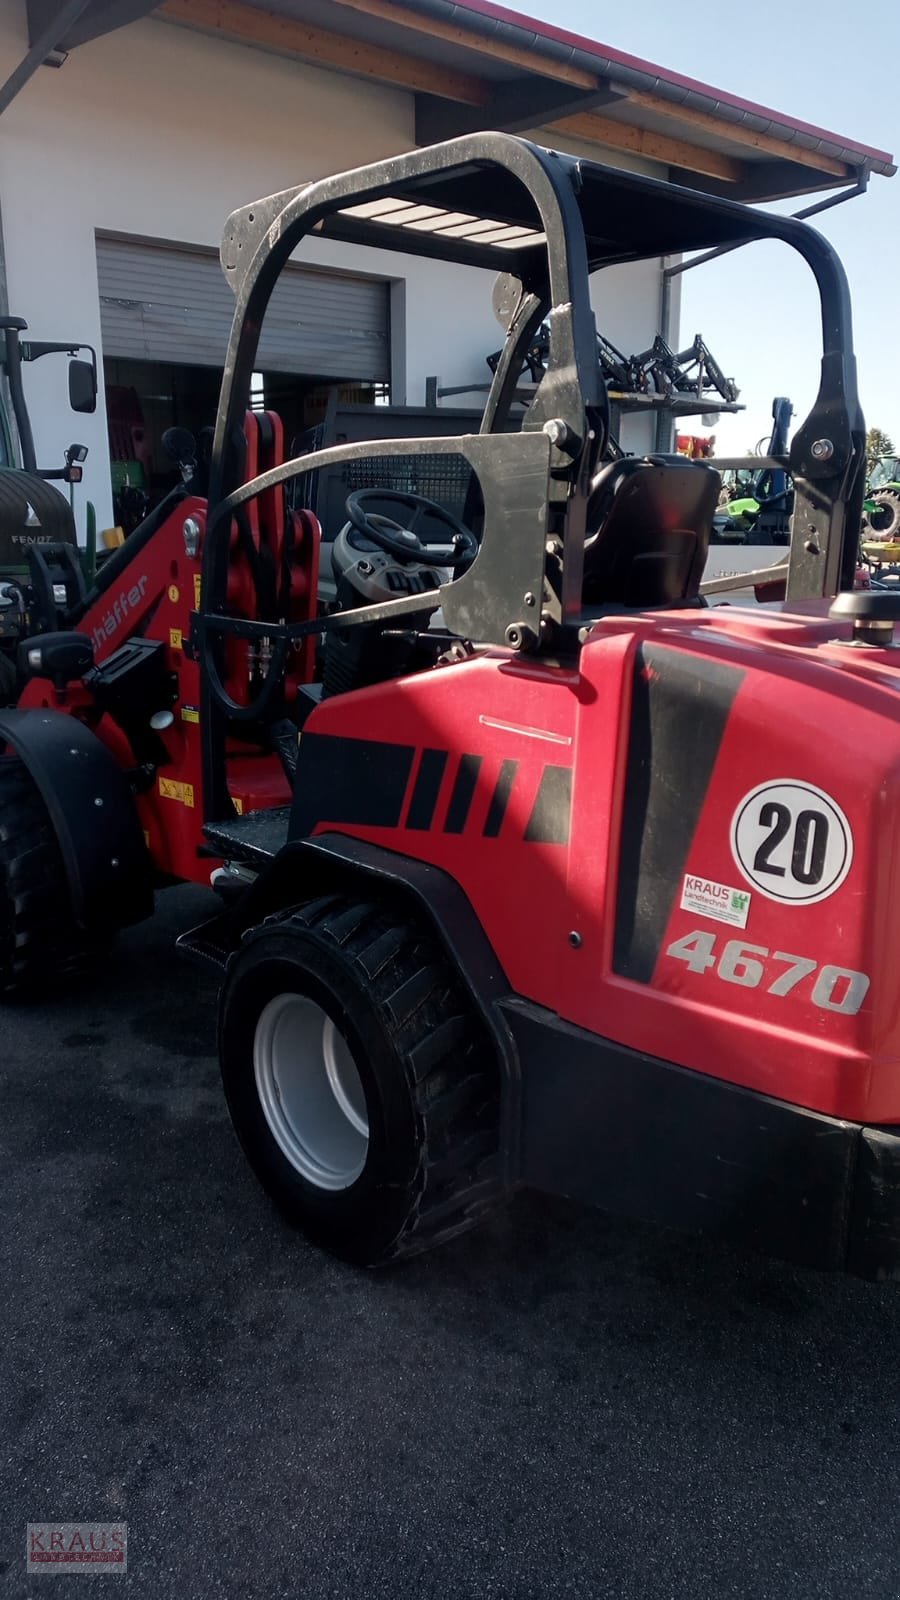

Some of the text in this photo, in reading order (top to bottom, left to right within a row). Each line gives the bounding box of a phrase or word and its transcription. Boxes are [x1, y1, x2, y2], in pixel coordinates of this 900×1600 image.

[11, 535, 53, 544] FENDT
[91, 575, 148, 654] häffer
[753, 801, 830, 885] 20
[686, 877, 730, 901] KRAUS
[666, 930, 871, 1016] 4670
